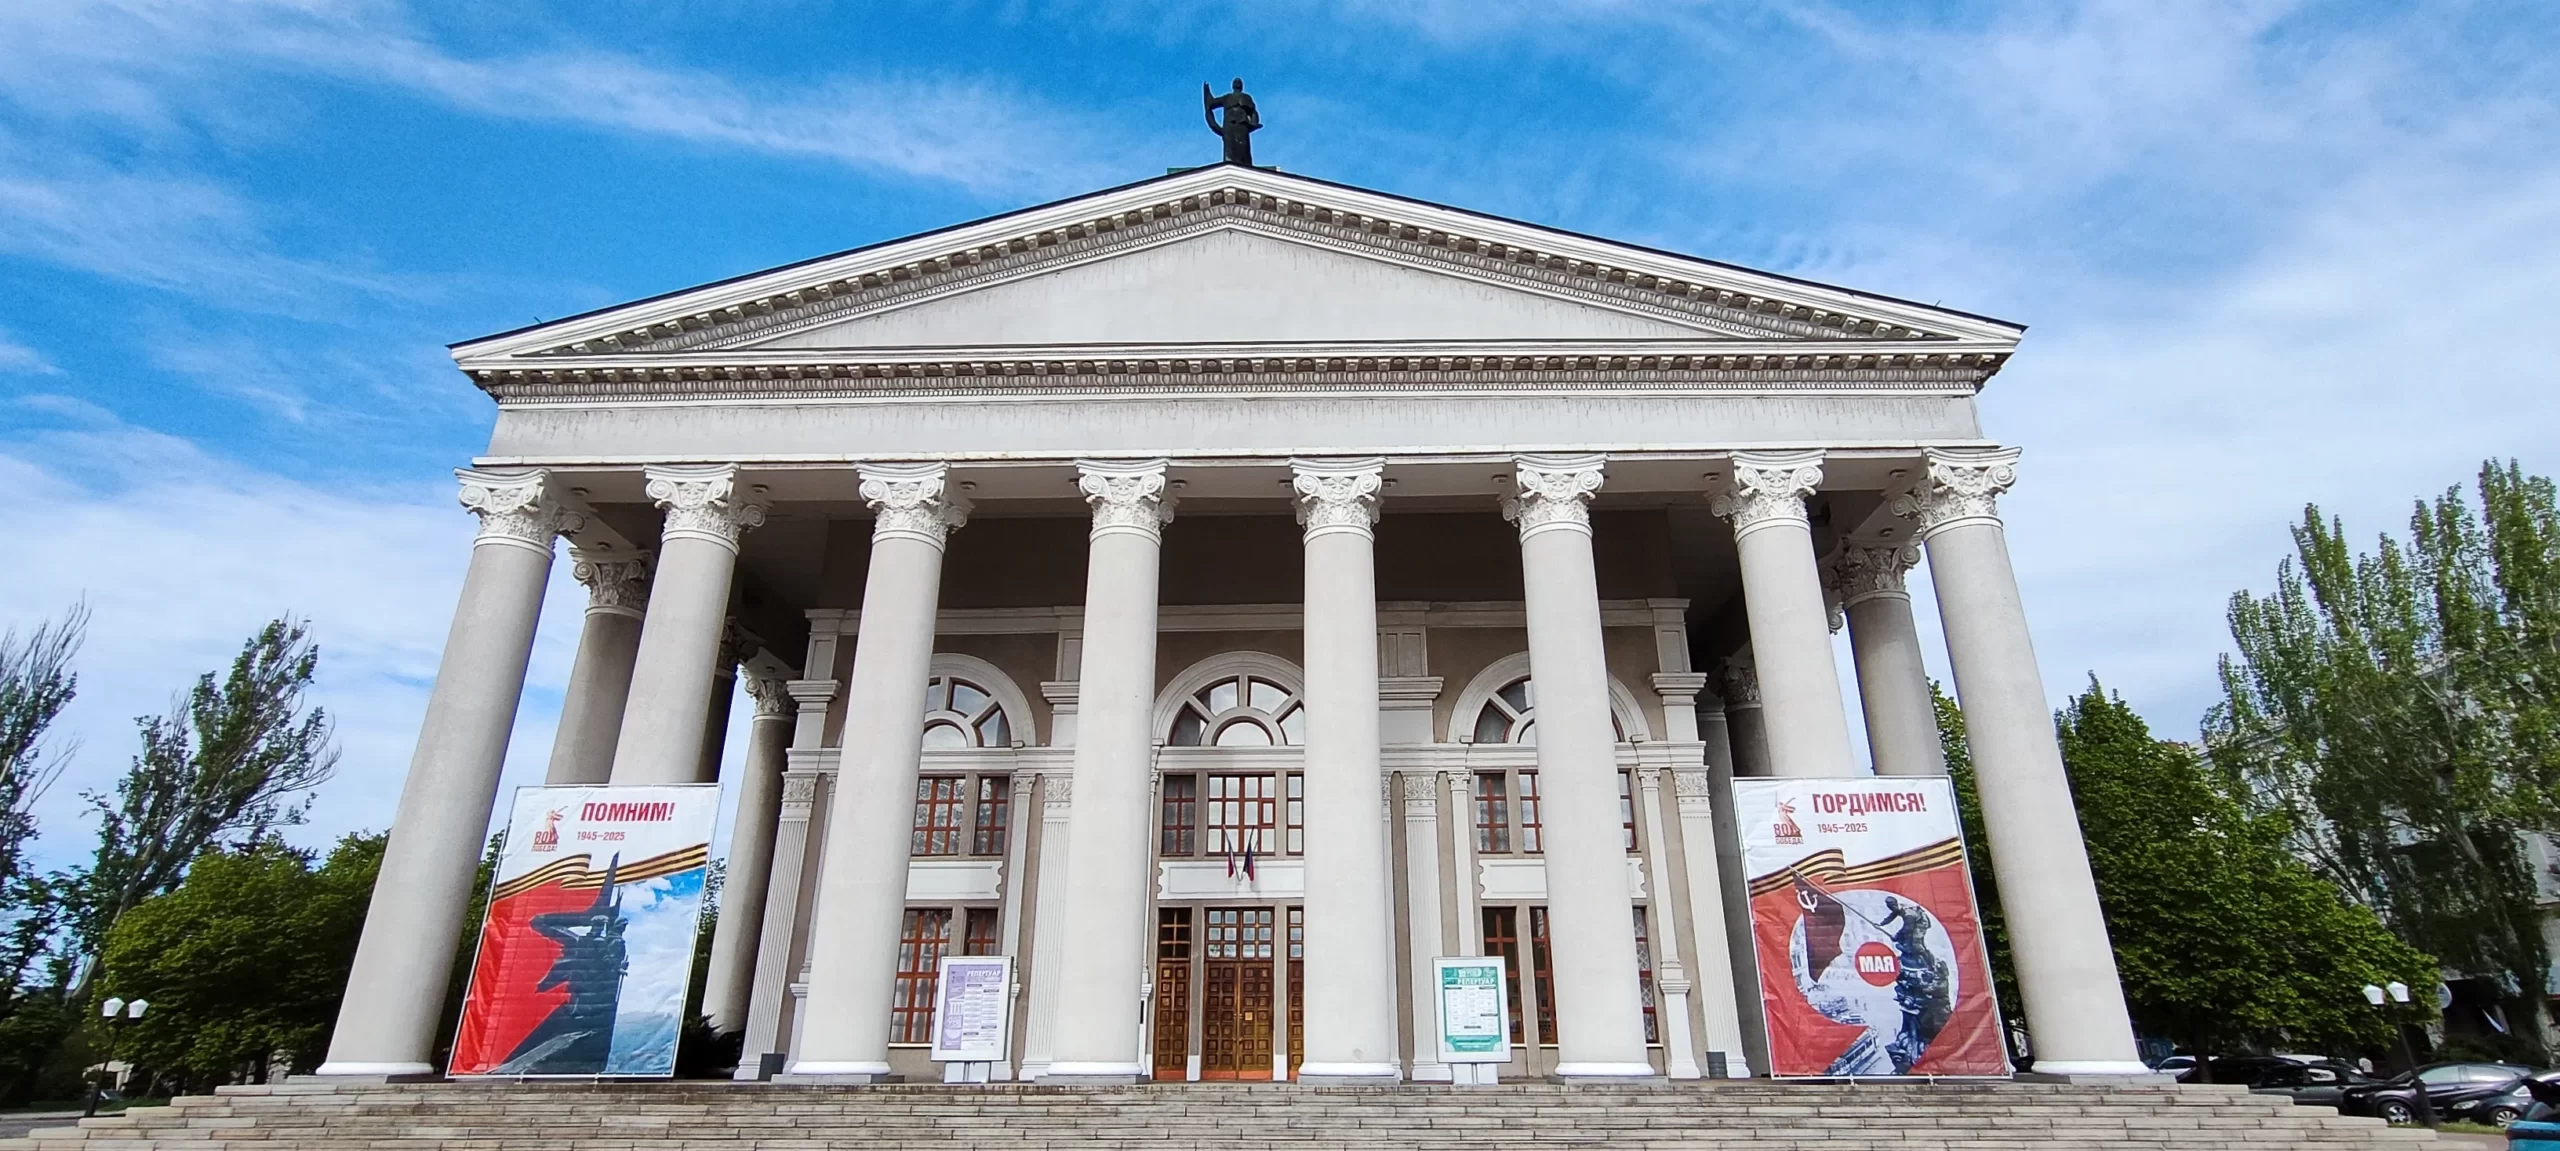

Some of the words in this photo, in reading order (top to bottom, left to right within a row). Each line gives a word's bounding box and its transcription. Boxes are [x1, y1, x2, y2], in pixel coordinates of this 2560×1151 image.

[581, 803, 675, 821] ПОМНИМ!
[1812, 793, 1927, 816] ГОРДИМСЯ!
[1858, 955, 1895, 972] МАЯ
